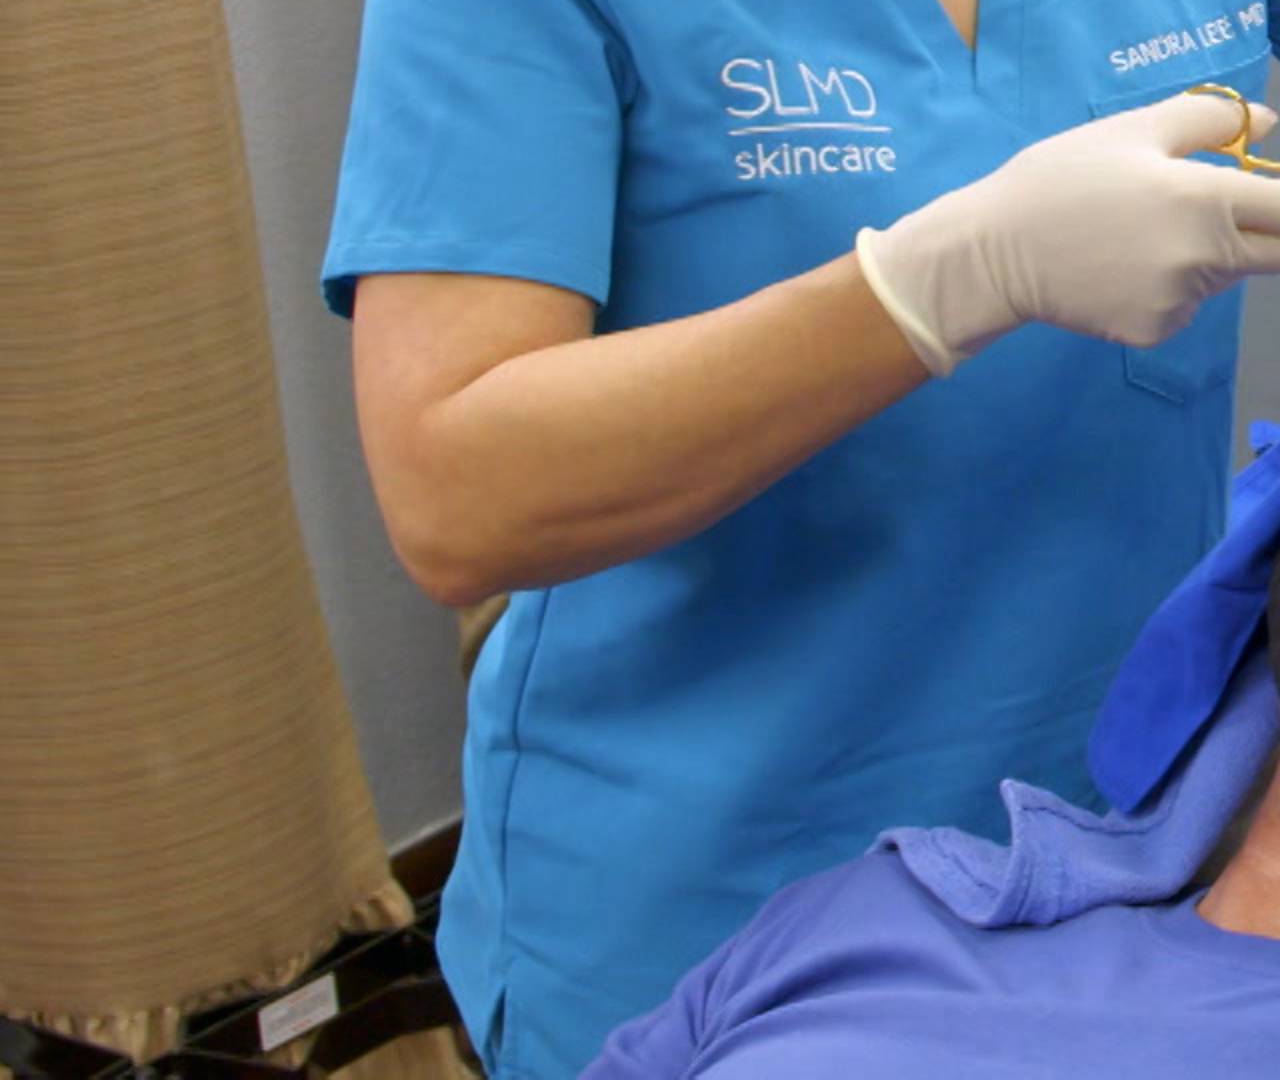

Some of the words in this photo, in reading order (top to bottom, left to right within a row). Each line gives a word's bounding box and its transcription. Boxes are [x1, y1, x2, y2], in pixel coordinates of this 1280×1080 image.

[1109, 31, 1198, 72] SANDRA
[1196, 15, 1234, 48] LEE
[720, 57, 878, 118] SLMD
[735, 142, 897, 180] skincare
